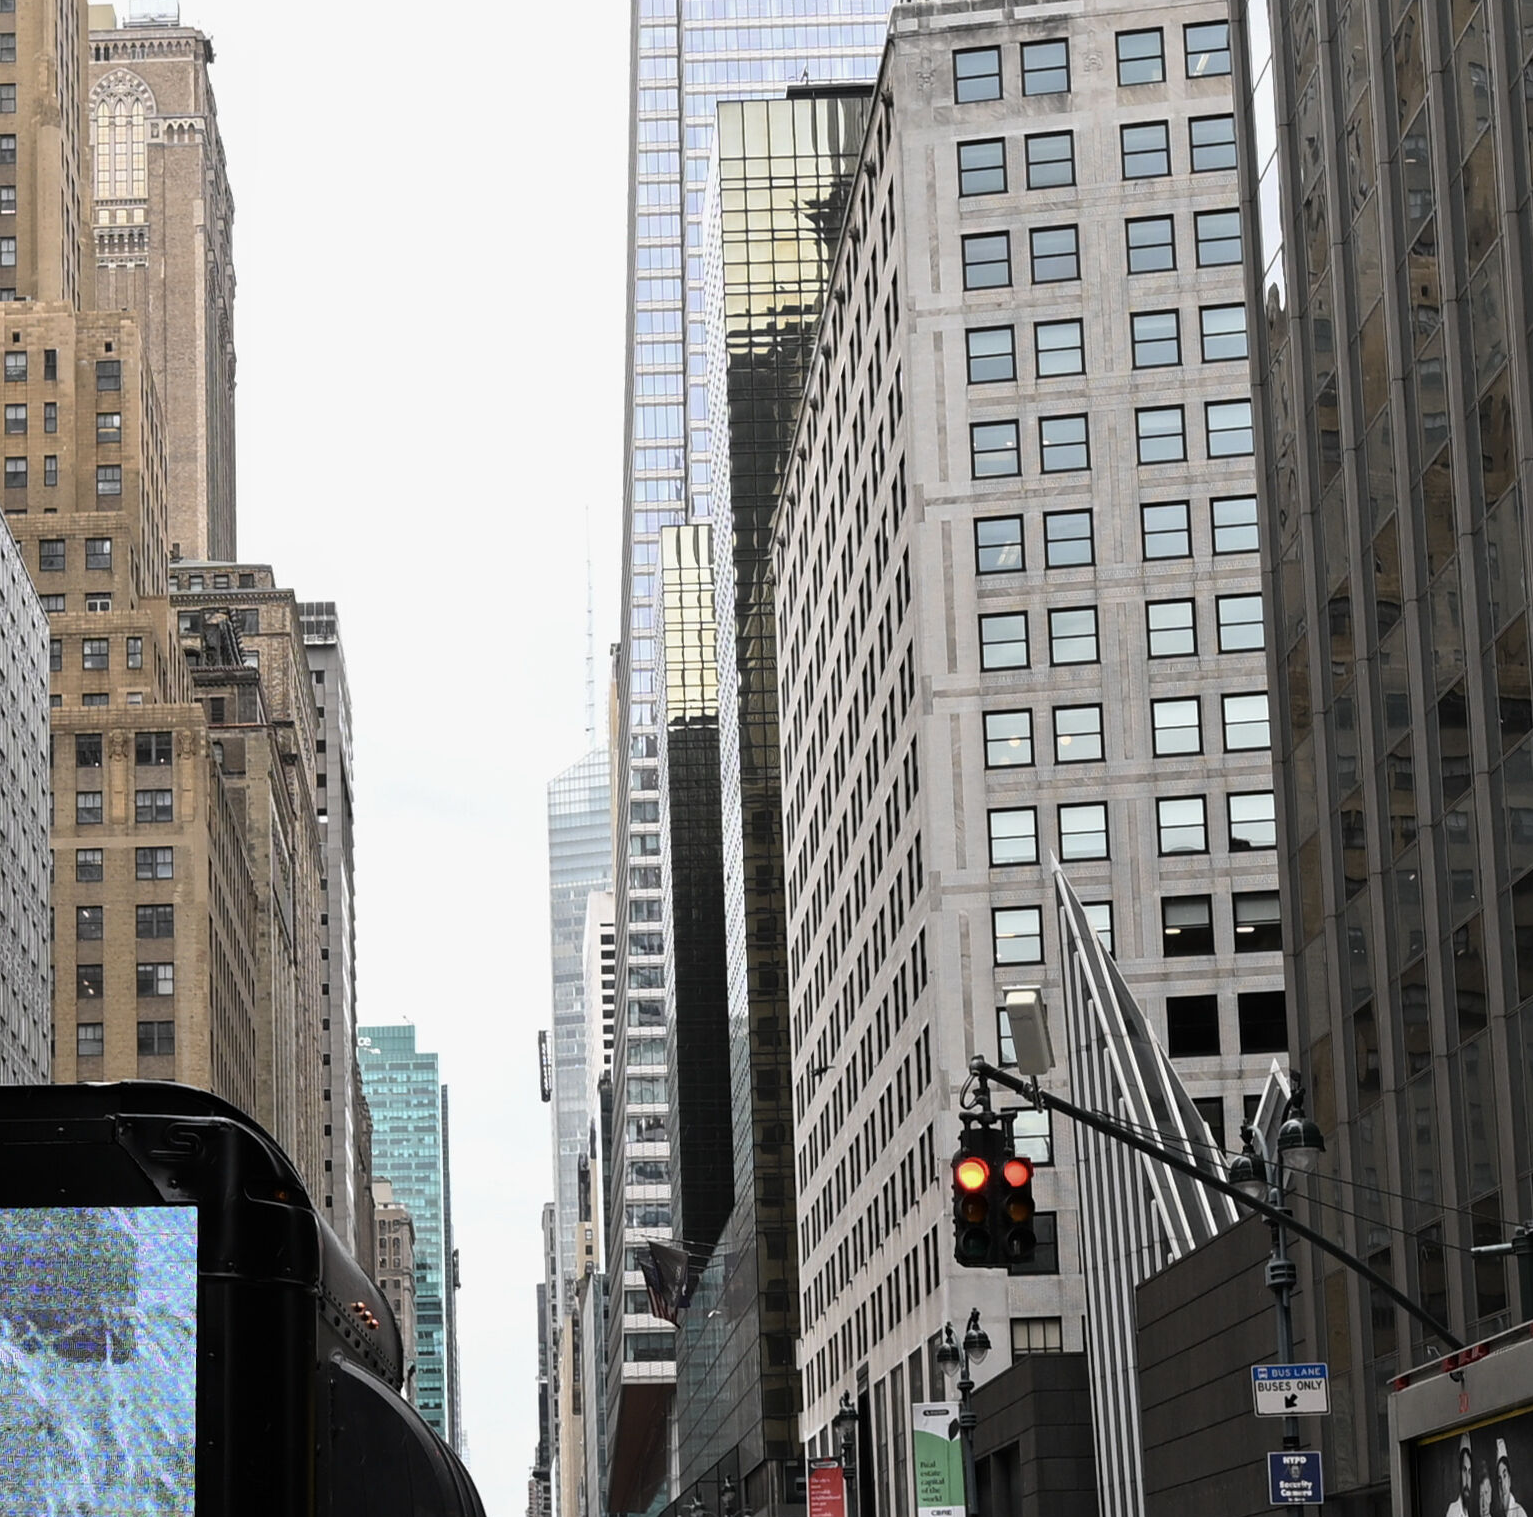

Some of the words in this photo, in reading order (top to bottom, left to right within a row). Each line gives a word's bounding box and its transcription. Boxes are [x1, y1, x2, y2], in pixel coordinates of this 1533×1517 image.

[1271, 1368, 1291, 1377] BUS
[1295, 1367, 1321, 1377] LANE
[1257, 1381, 1291, 1392] BUSES
[1296, 1380, 1322, 1391] ONLY
[1279, 1480, 1313, 1490] Security
